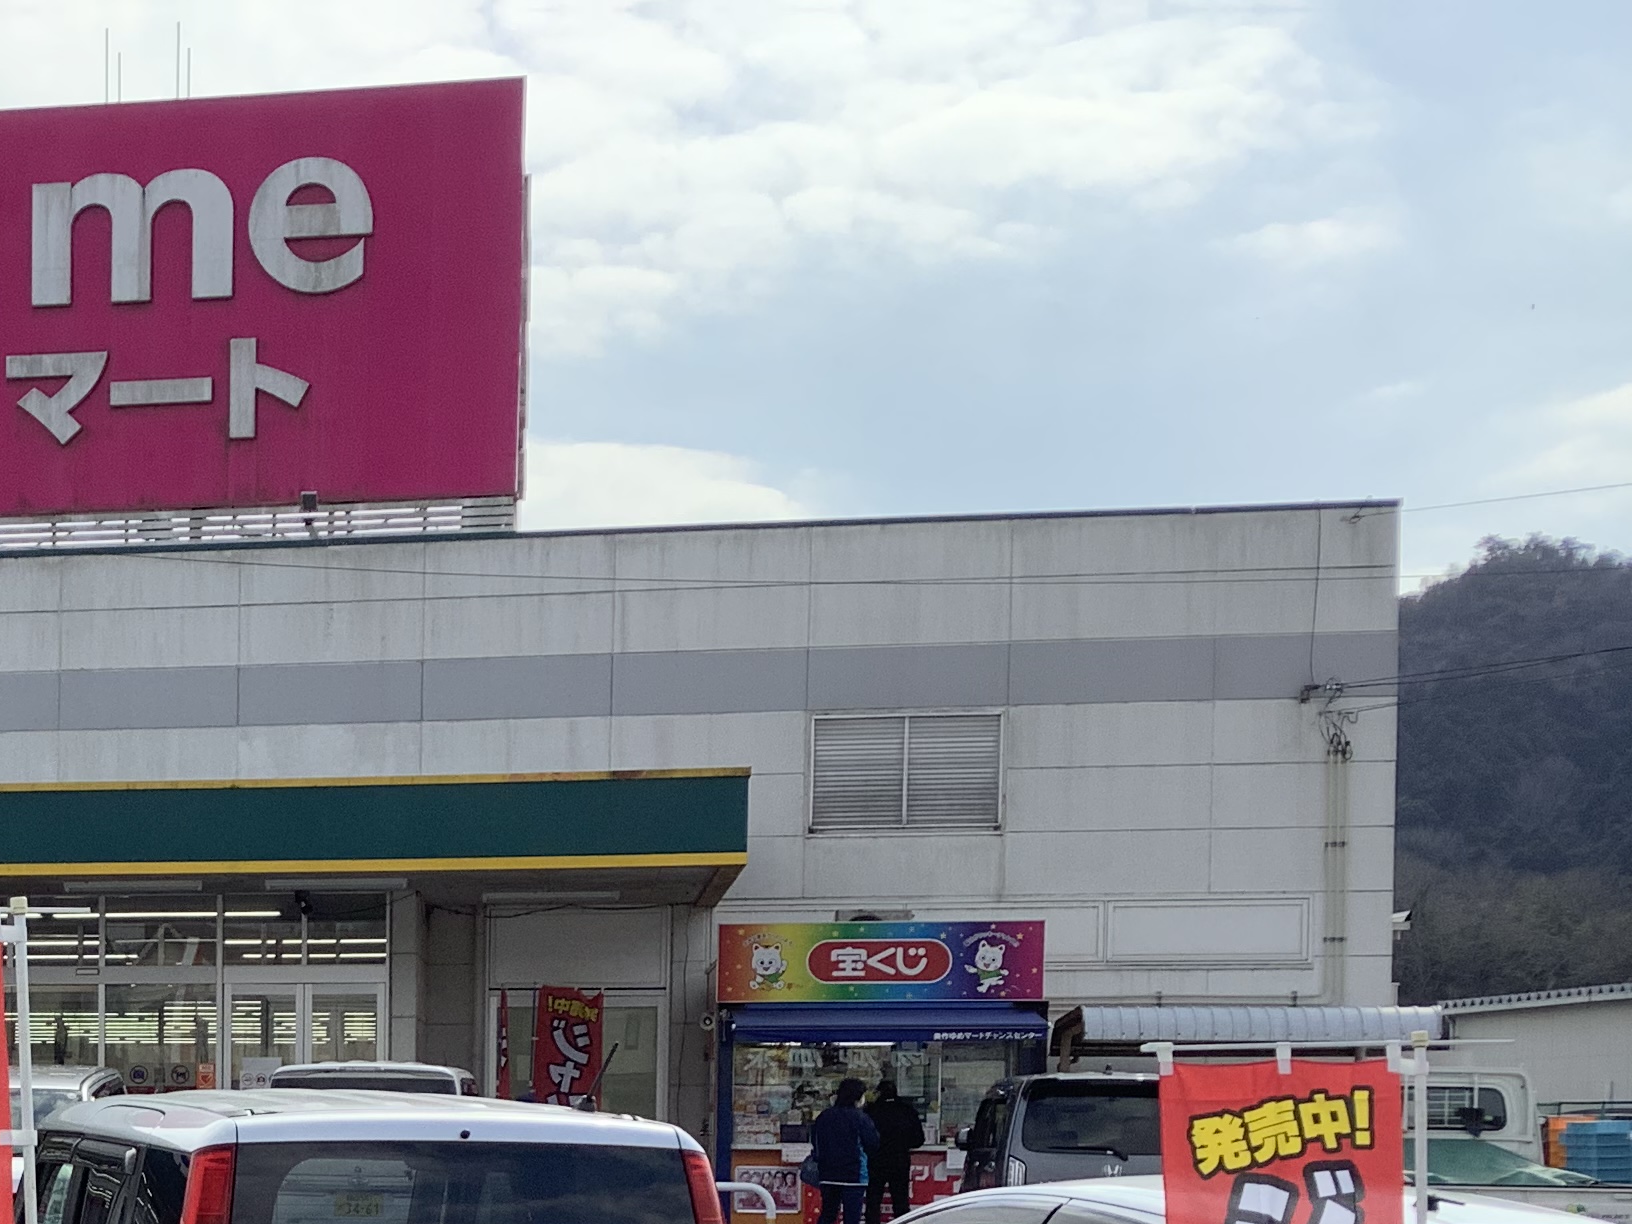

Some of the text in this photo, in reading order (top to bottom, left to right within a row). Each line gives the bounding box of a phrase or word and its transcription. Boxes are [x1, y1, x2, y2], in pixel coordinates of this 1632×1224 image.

[30, 155, 374, 308] me
[5, 336, 310, 445] マート
[830, 946, 929, 978] 宝くじ
[1190, 1088, 1372, 1177] 発売中!
